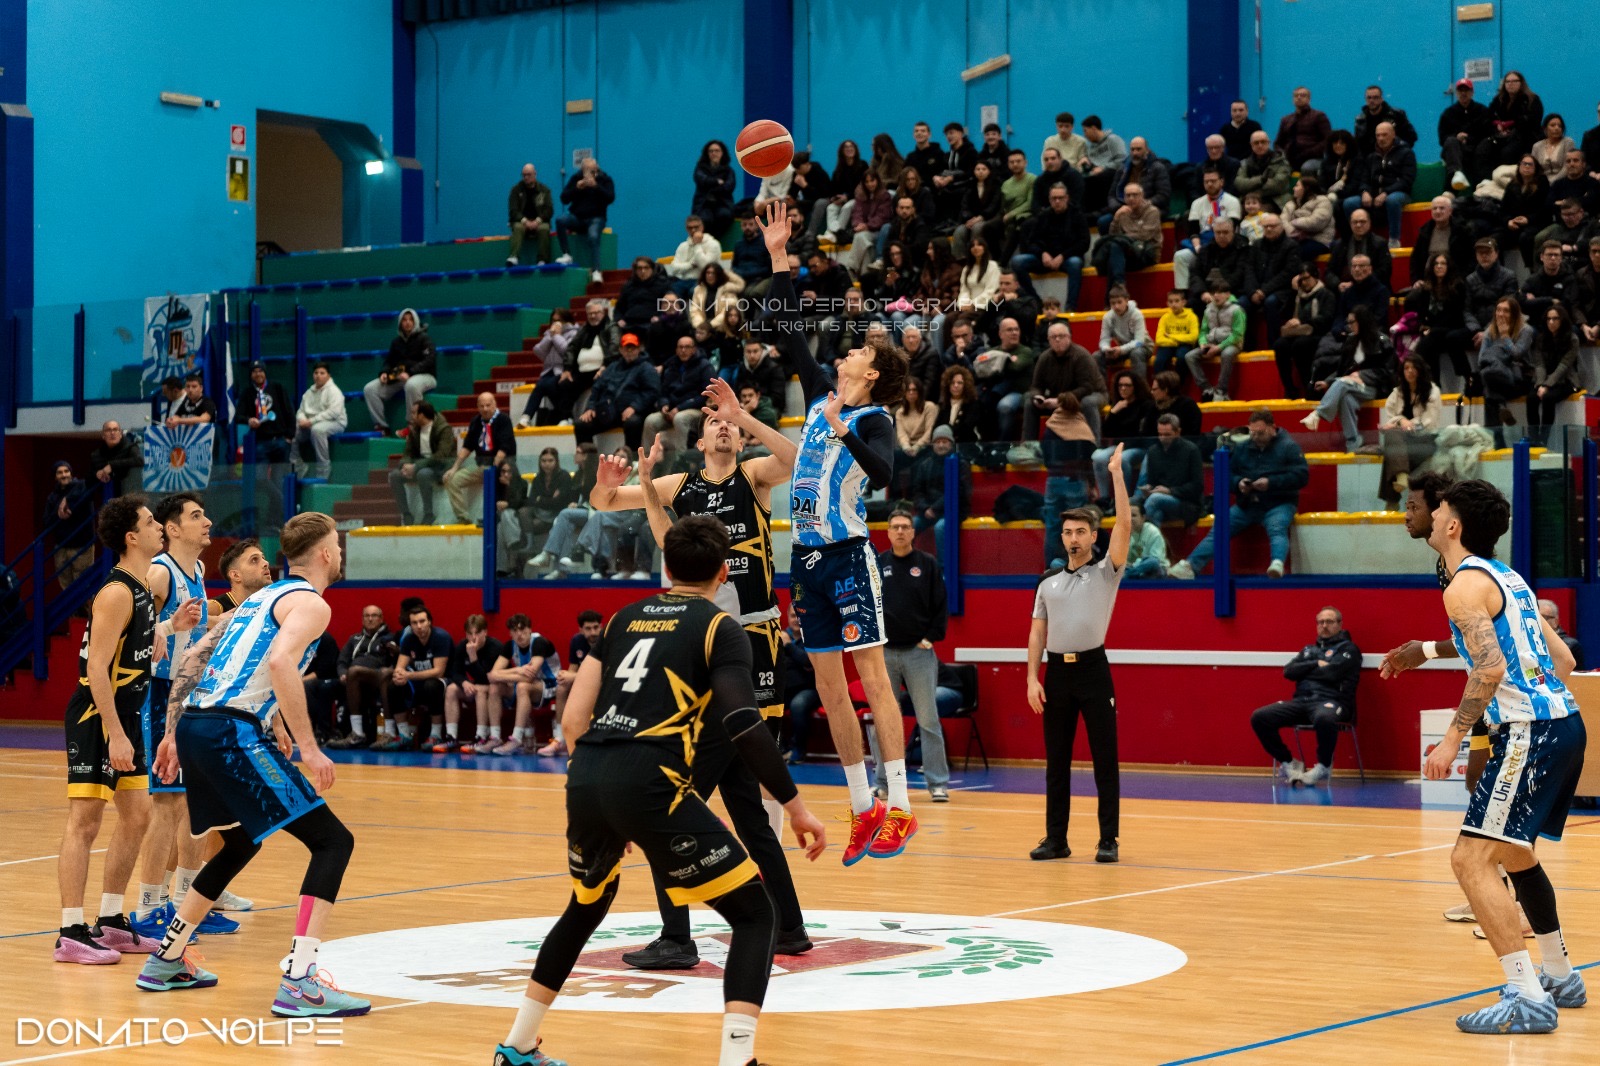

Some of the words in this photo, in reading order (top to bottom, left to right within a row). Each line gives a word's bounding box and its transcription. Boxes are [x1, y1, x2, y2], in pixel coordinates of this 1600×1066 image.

[216, 622, 244, 656] 7
[626, 618, 680, 633] PAVICEVIC
[614, 637, 656, 693] 4
[758, 671, 775, 687] 23
[1492, 742, 1523, 803] Unicenter
[699, 843, 732, 867] FITACTIVE
